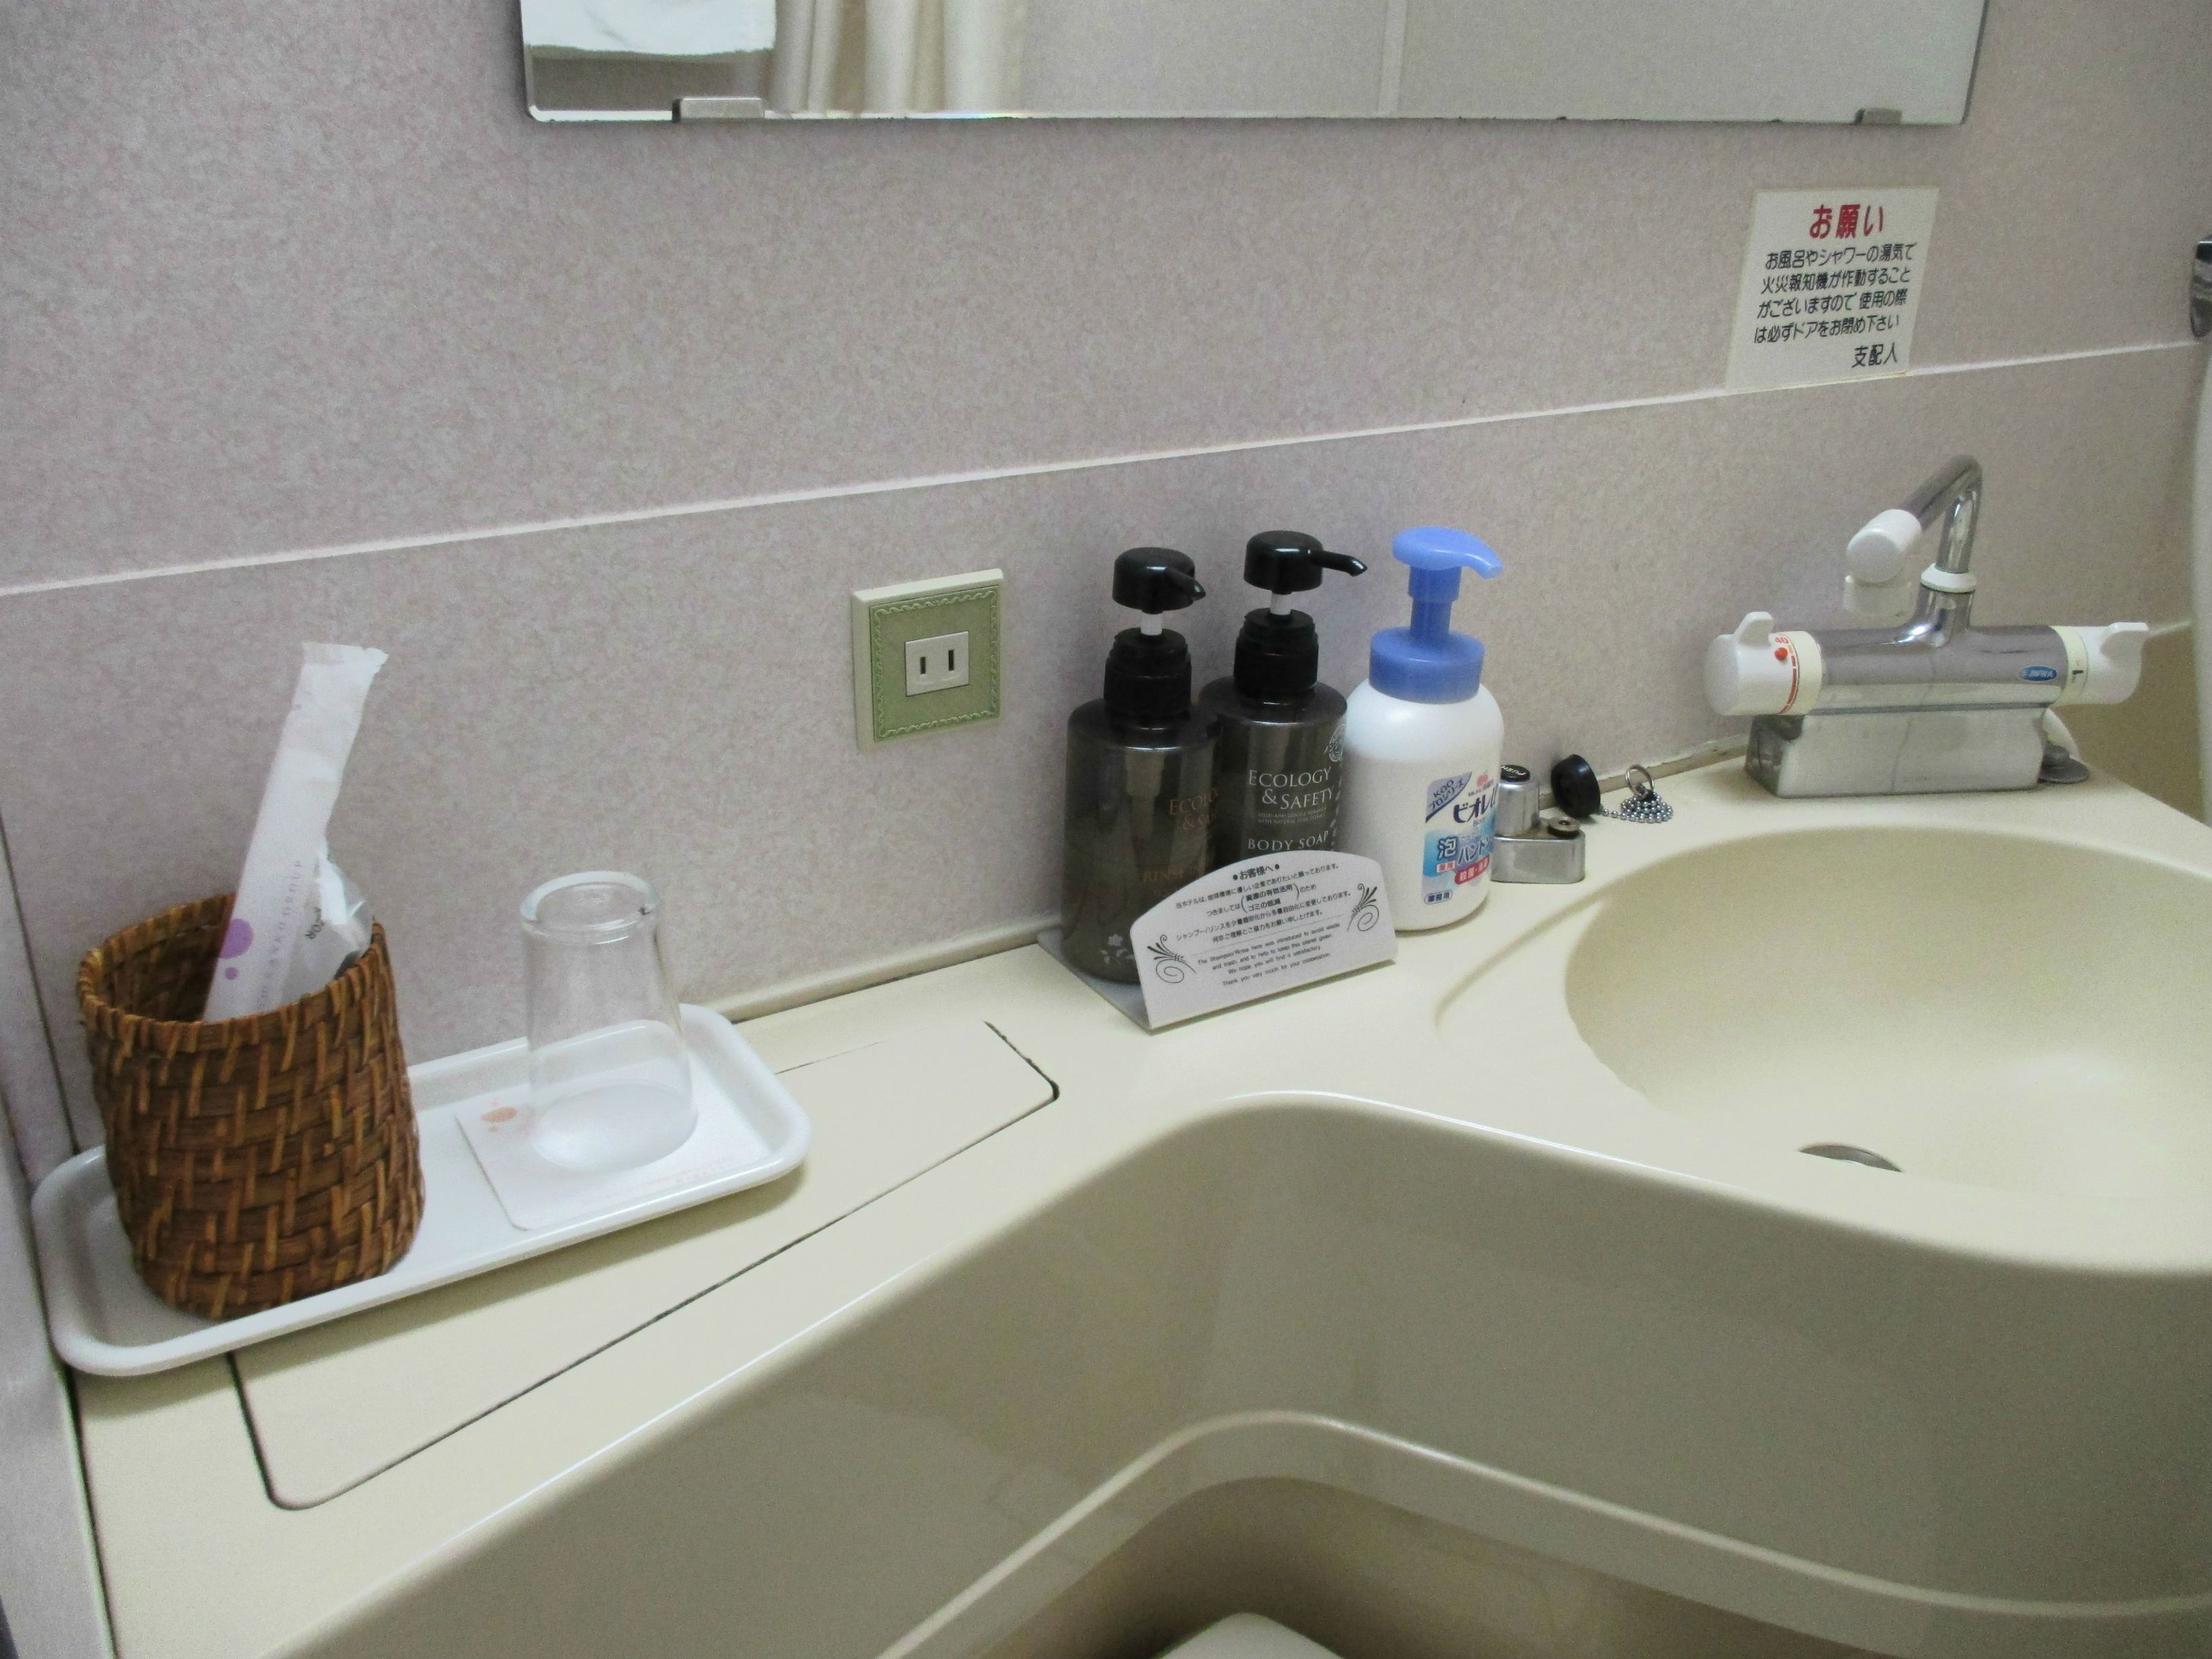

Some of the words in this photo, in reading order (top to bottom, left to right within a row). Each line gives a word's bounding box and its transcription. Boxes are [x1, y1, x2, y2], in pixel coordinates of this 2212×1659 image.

[1810, 204, 1884, 239] お願い
[1765, 242, 1918, 270] お風呂やシャワーの湯気で
[1761, 266, 1911, 295] 火災報知機が作動すること
[1753, 314, 1900, 344] は必ずドアをお閉め下さい
[1851, 341, 1898, 369] 支配人
[1249, 766, 1331, 787] ECOLOGY
[1169, 787, 1218, 816] ECOLO
[1261, 789, 1278, 805] &
[1280, 786, 1334, 810] SAFETY
[1248, 838, 1294, 852] BODY
[1297, 831, 1329, 849] SOAP
[1438, 837, 1457, 860] 泡
[1299, 883, 1317, 894] のため
